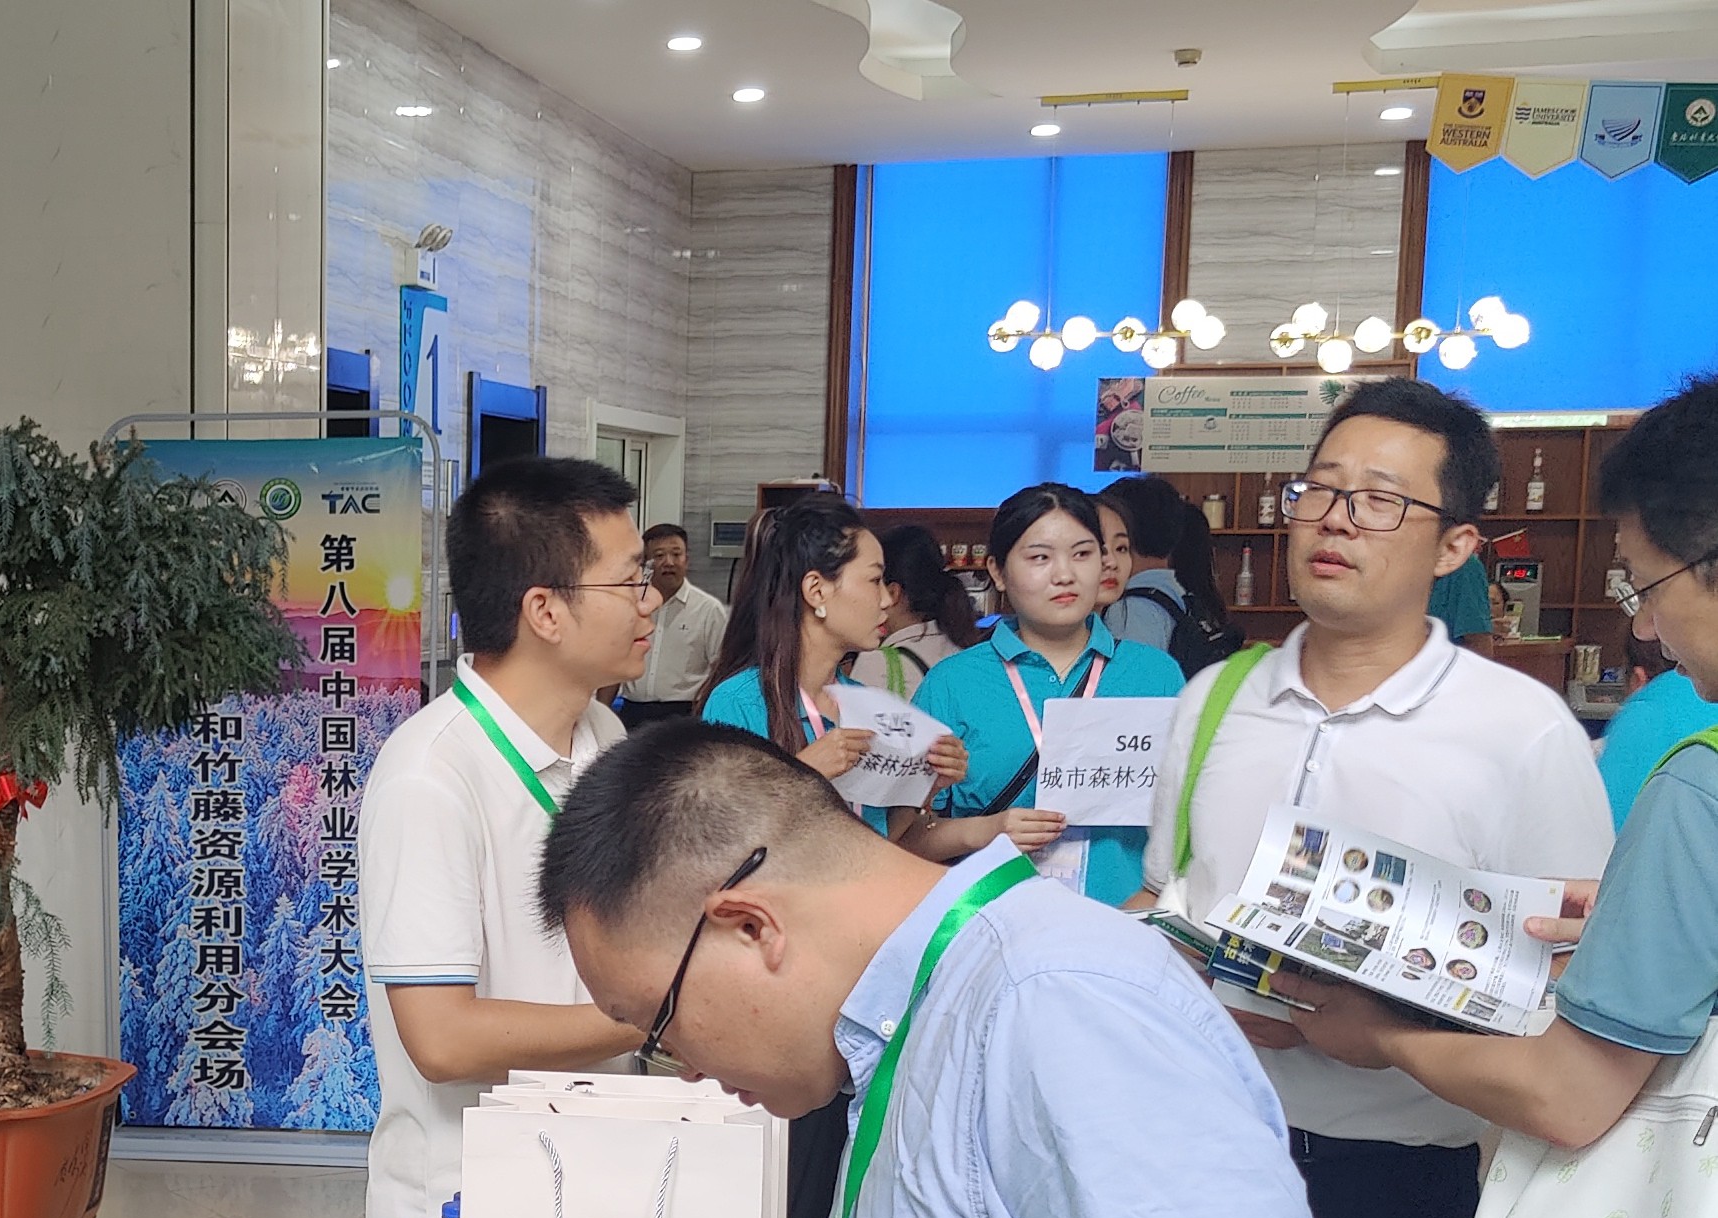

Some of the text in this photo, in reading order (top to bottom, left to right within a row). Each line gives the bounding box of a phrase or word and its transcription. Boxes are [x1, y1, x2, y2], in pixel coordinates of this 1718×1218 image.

[1440, 138, 1489, 147] AUSTRALIA
[1442, 128, 1491, 140] WESTERN
[426, 334, 443, 436] 1
[1157, 384, 1207, 406] Coffee
[321, 491, 381, 515] TAC
[1115, 734, 1152, 753] S46
[319, 533, 358, 1021] 第八届中国林业学术大会
[1040, 765, 1159, 790] 城市森林分
[191, 711, 245, 1090] 和竹藤资源利用分会场
